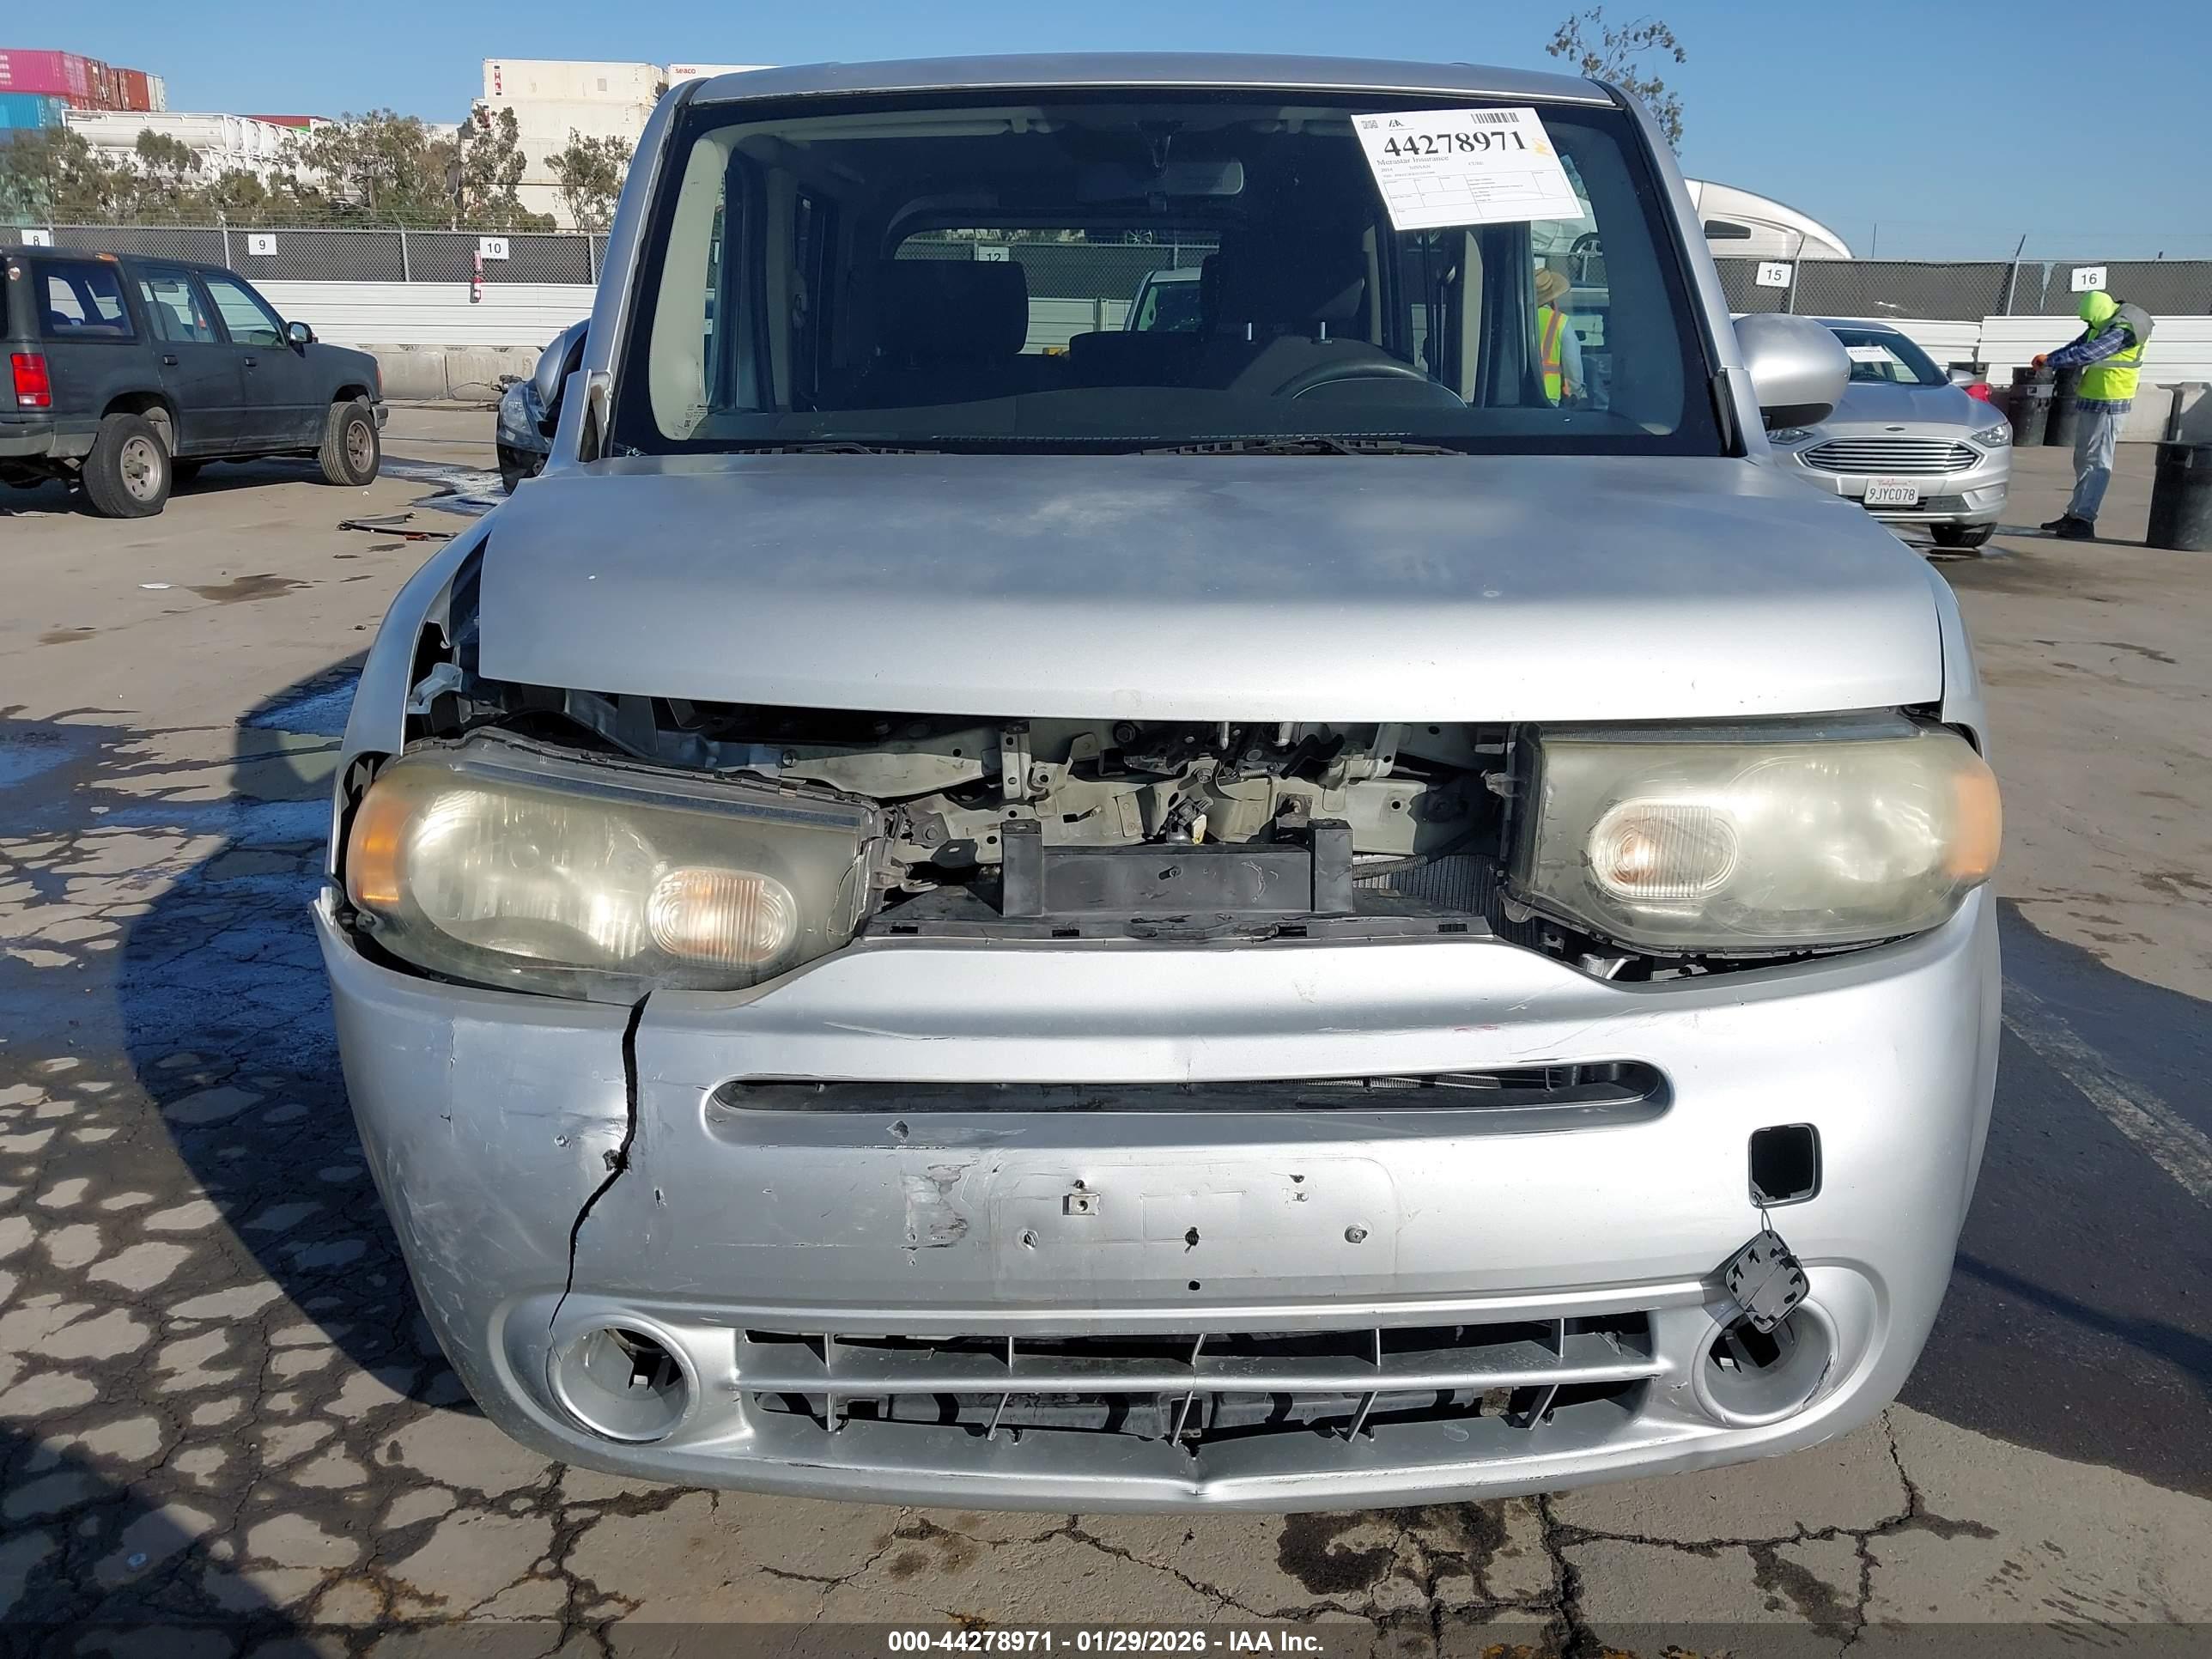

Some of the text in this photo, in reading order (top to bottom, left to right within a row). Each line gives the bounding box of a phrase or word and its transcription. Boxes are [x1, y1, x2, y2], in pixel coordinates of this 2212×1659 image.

[1383, 131, 1528, 157] 44278971
[258, 240, 266, 250] 9
[487, 242, 502, 254] 10
[1766, 268, 1784, 281] 15
[2081, 273, 2098, 284] 16
[1869, 487, 1916, 501] 9JYC078
